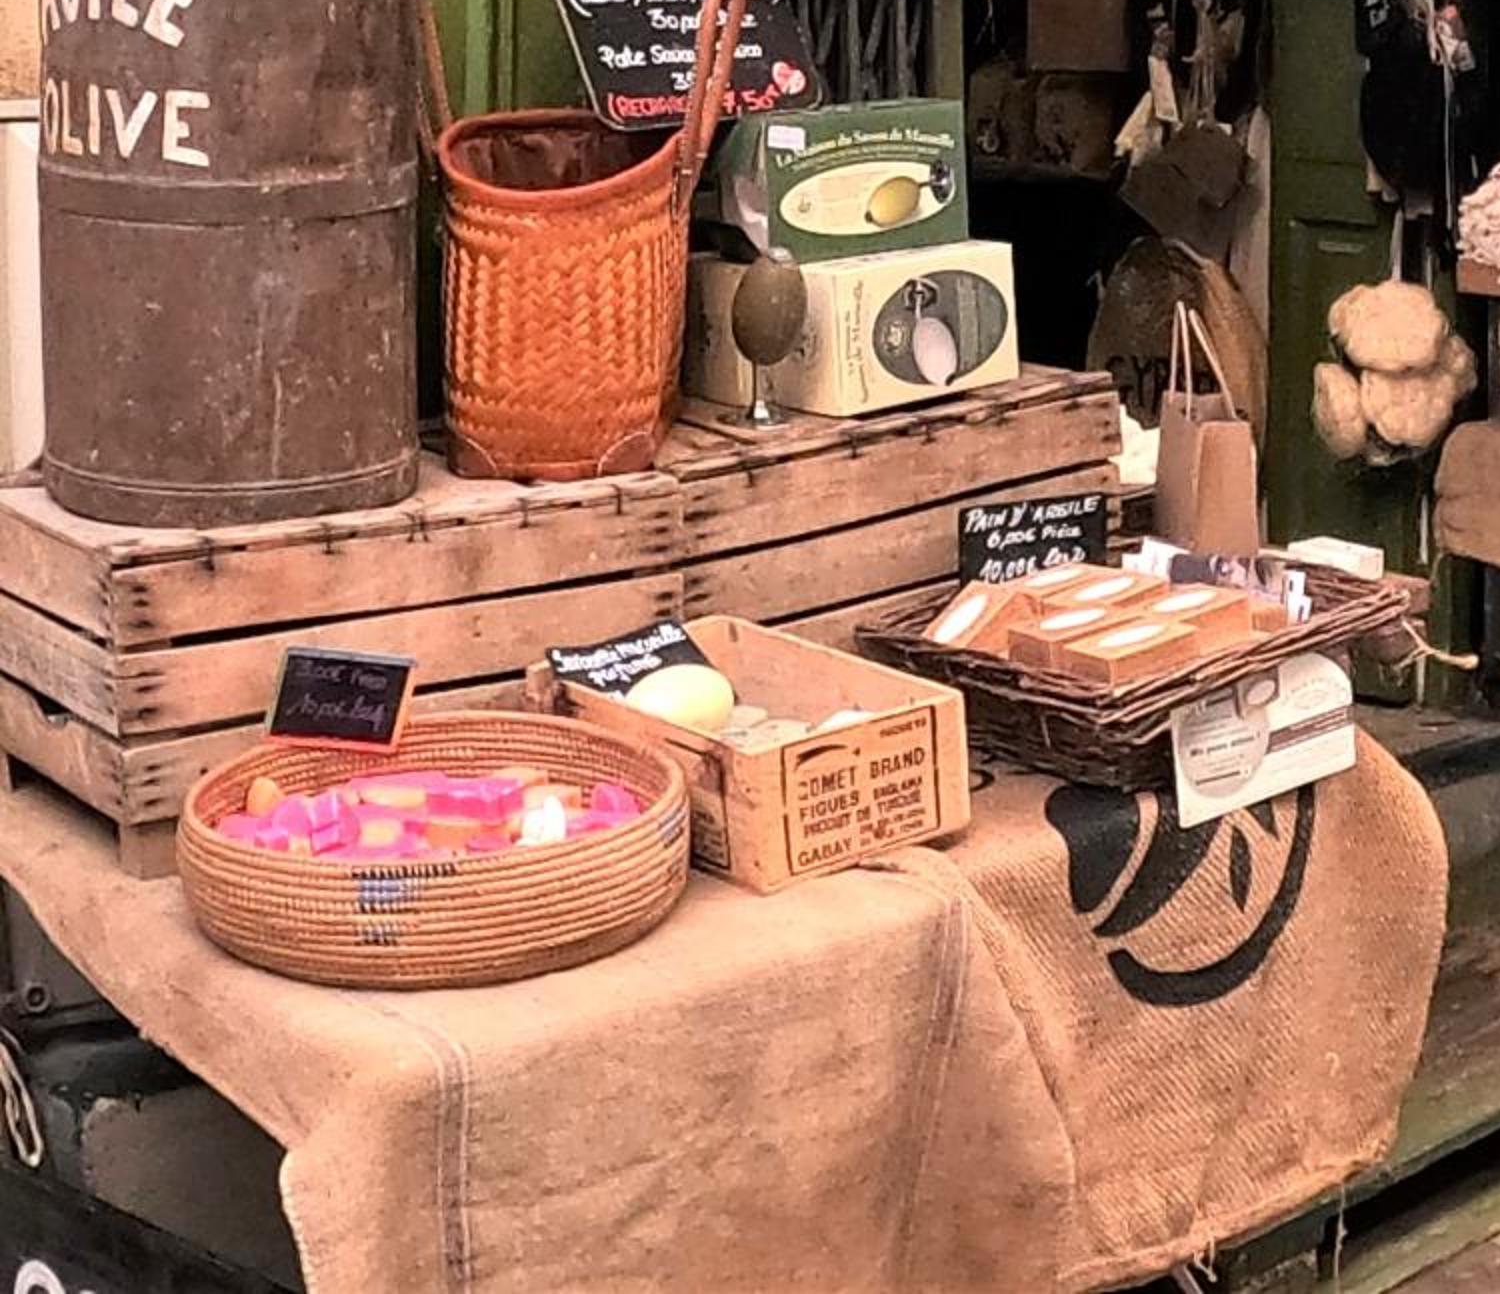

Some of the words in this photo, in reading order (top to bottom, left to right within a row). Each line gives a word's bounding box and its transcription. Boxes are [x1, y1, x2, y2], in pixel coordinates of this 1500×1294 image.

[964, 507, 1008, 534] PAIN
[869, 746, 926, 780] BRAND
[799, 789, 861, 822] FIGUES
